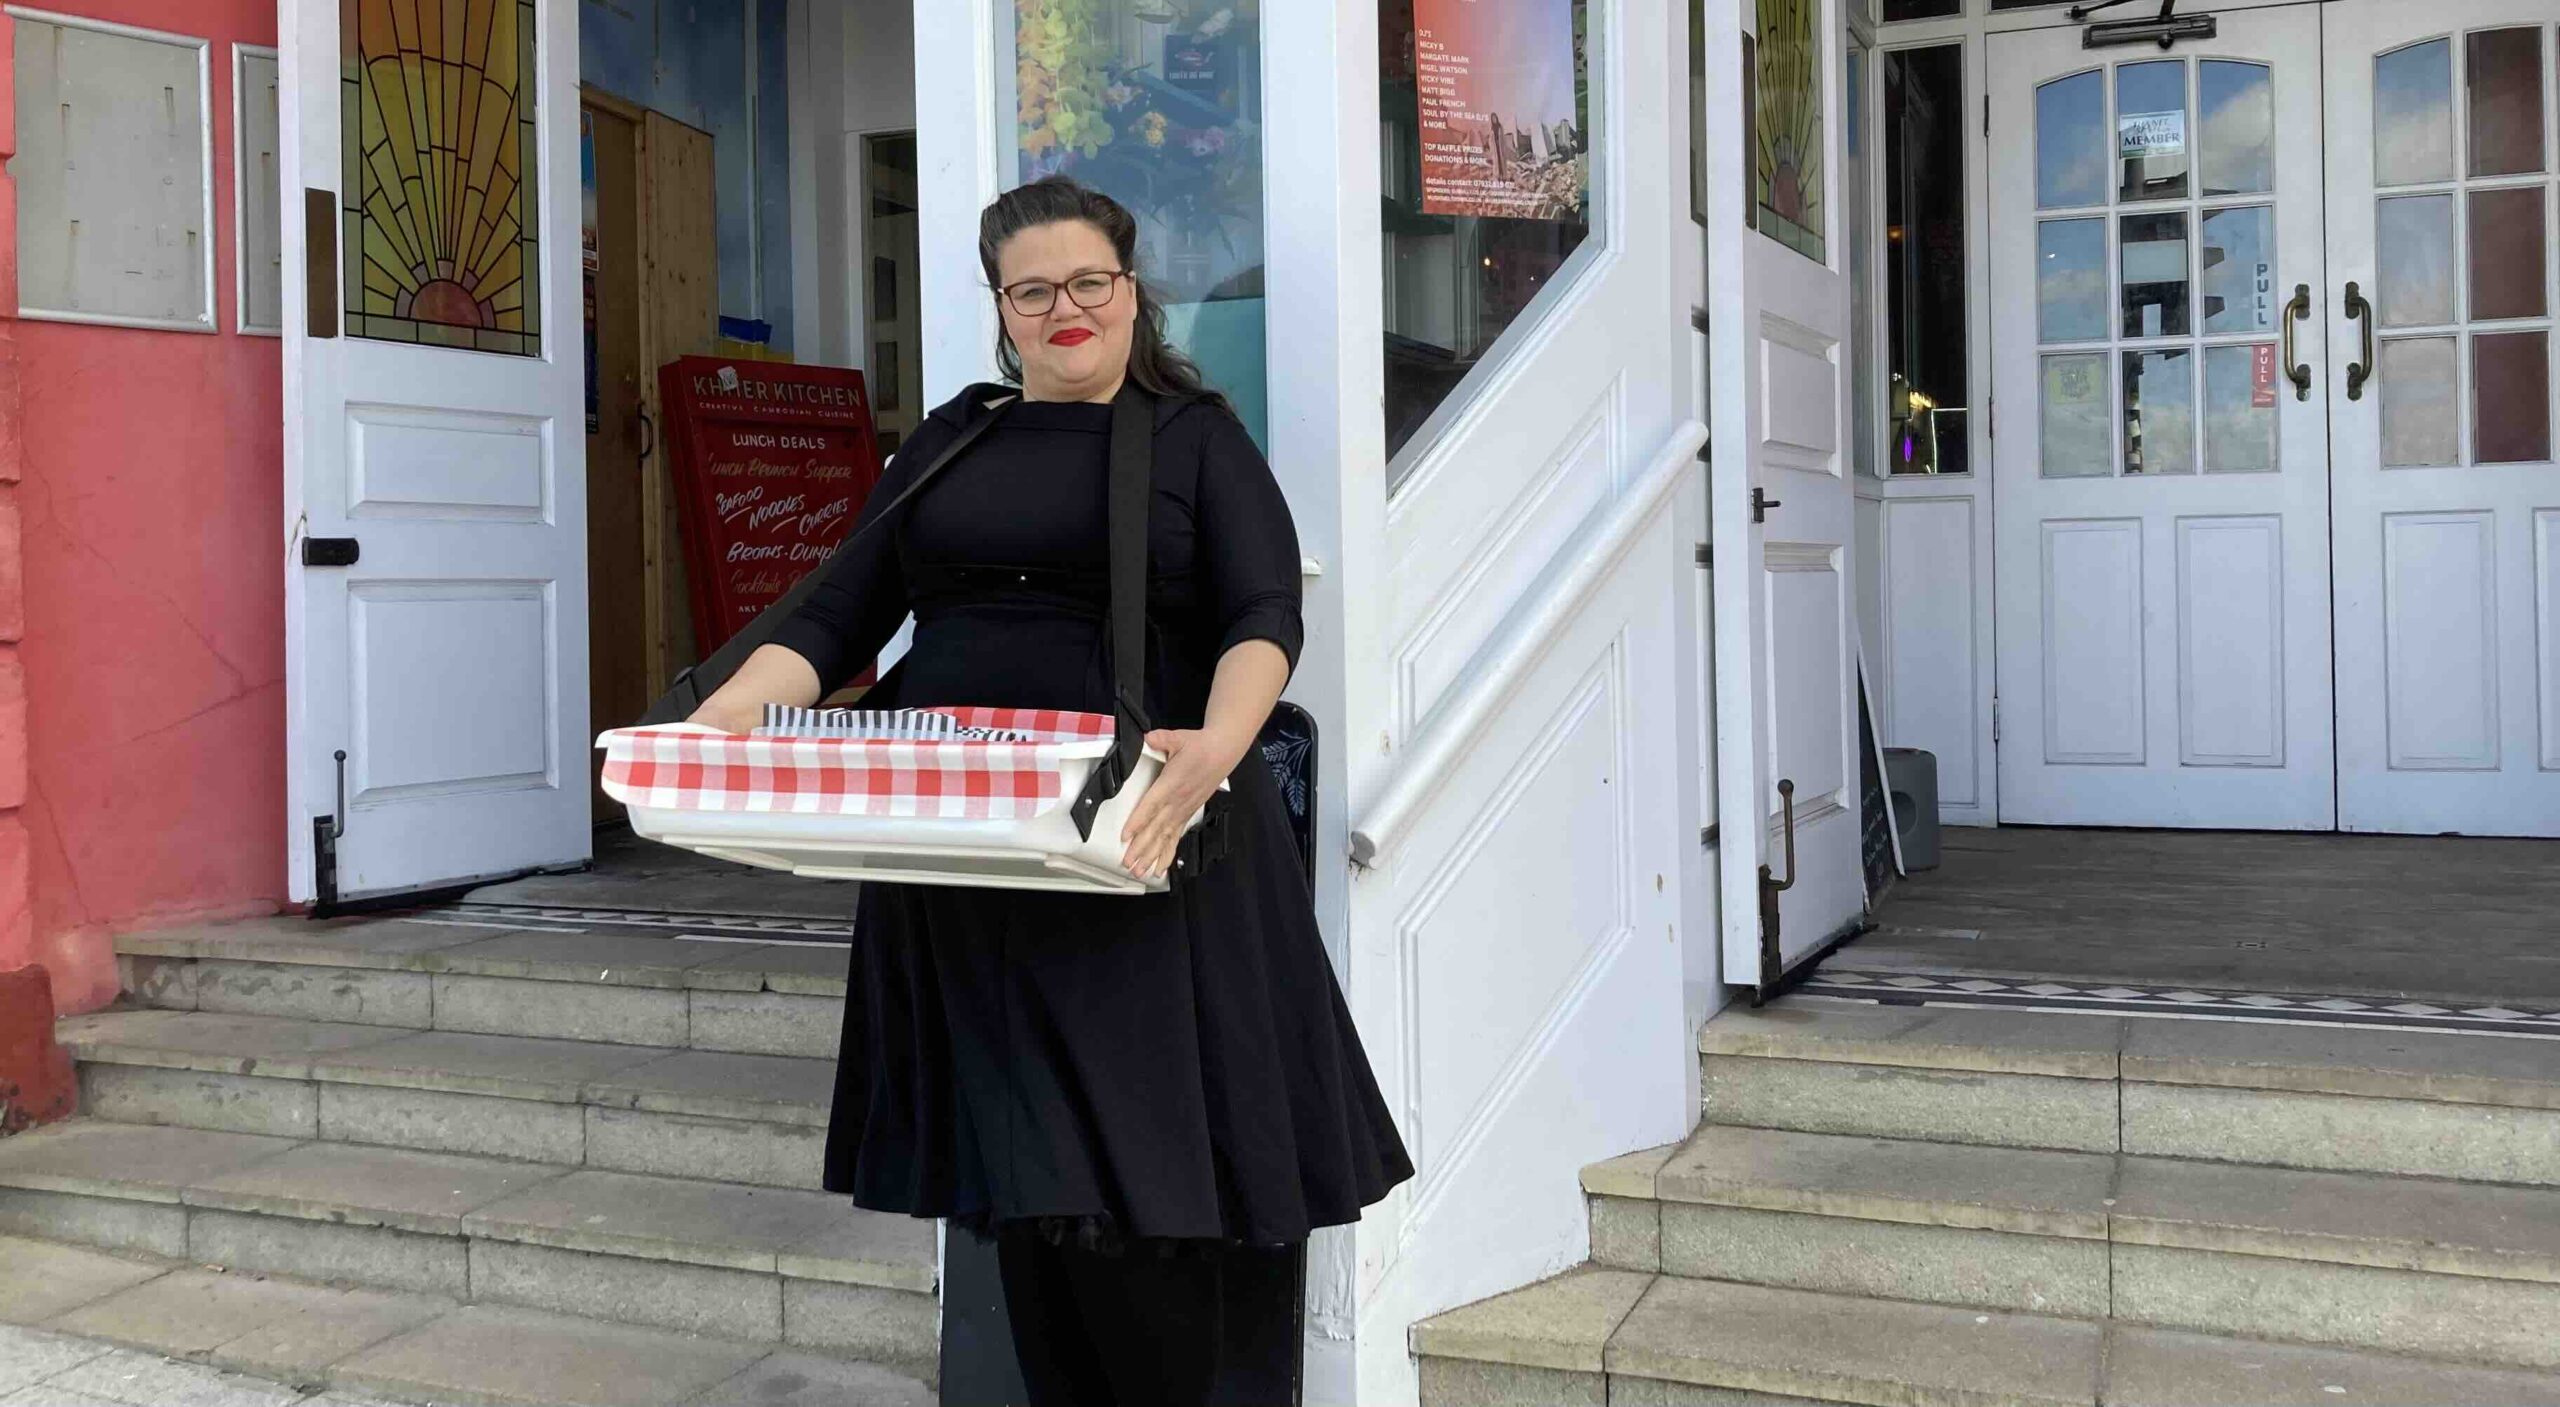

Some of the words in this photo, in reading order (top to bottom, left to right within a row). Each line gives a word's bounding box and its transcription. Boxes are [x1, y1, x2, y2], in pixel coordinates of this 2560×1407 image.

[1420, 52, 1449, 62] MARGATE
[1439, 65, 1468, 74] WATSON
[1421, 86, 1439, 94] MATT
[1422, 97, 1438, 105] PAUL
[1439, 99, 1466, 107] FRENCH
[1422, 108, 1438, 117] SOUL
[1440, 110, 1448, 118] BY
[1428, 121, 1447, 129] MORE
[2124, 132, 2180, 146] MEMBER
[1424, 143, 1436, 151] TOP
[1437, 143, 1461, 152] RAFFLE
[1424, 154, 1463, 164] DONATIONS
[2257, 264, 2269, 325] PULL
[2260, 348, 2268, 383] PULL
[774, 382, 862, 407] KITCHEN
[733, 433, 775, 448] LUNCH
[781, 436, 826, 450] DEALS
[748, 494, 807, 532] NOODLES
[798, 497, 849, 536] CURRIES
